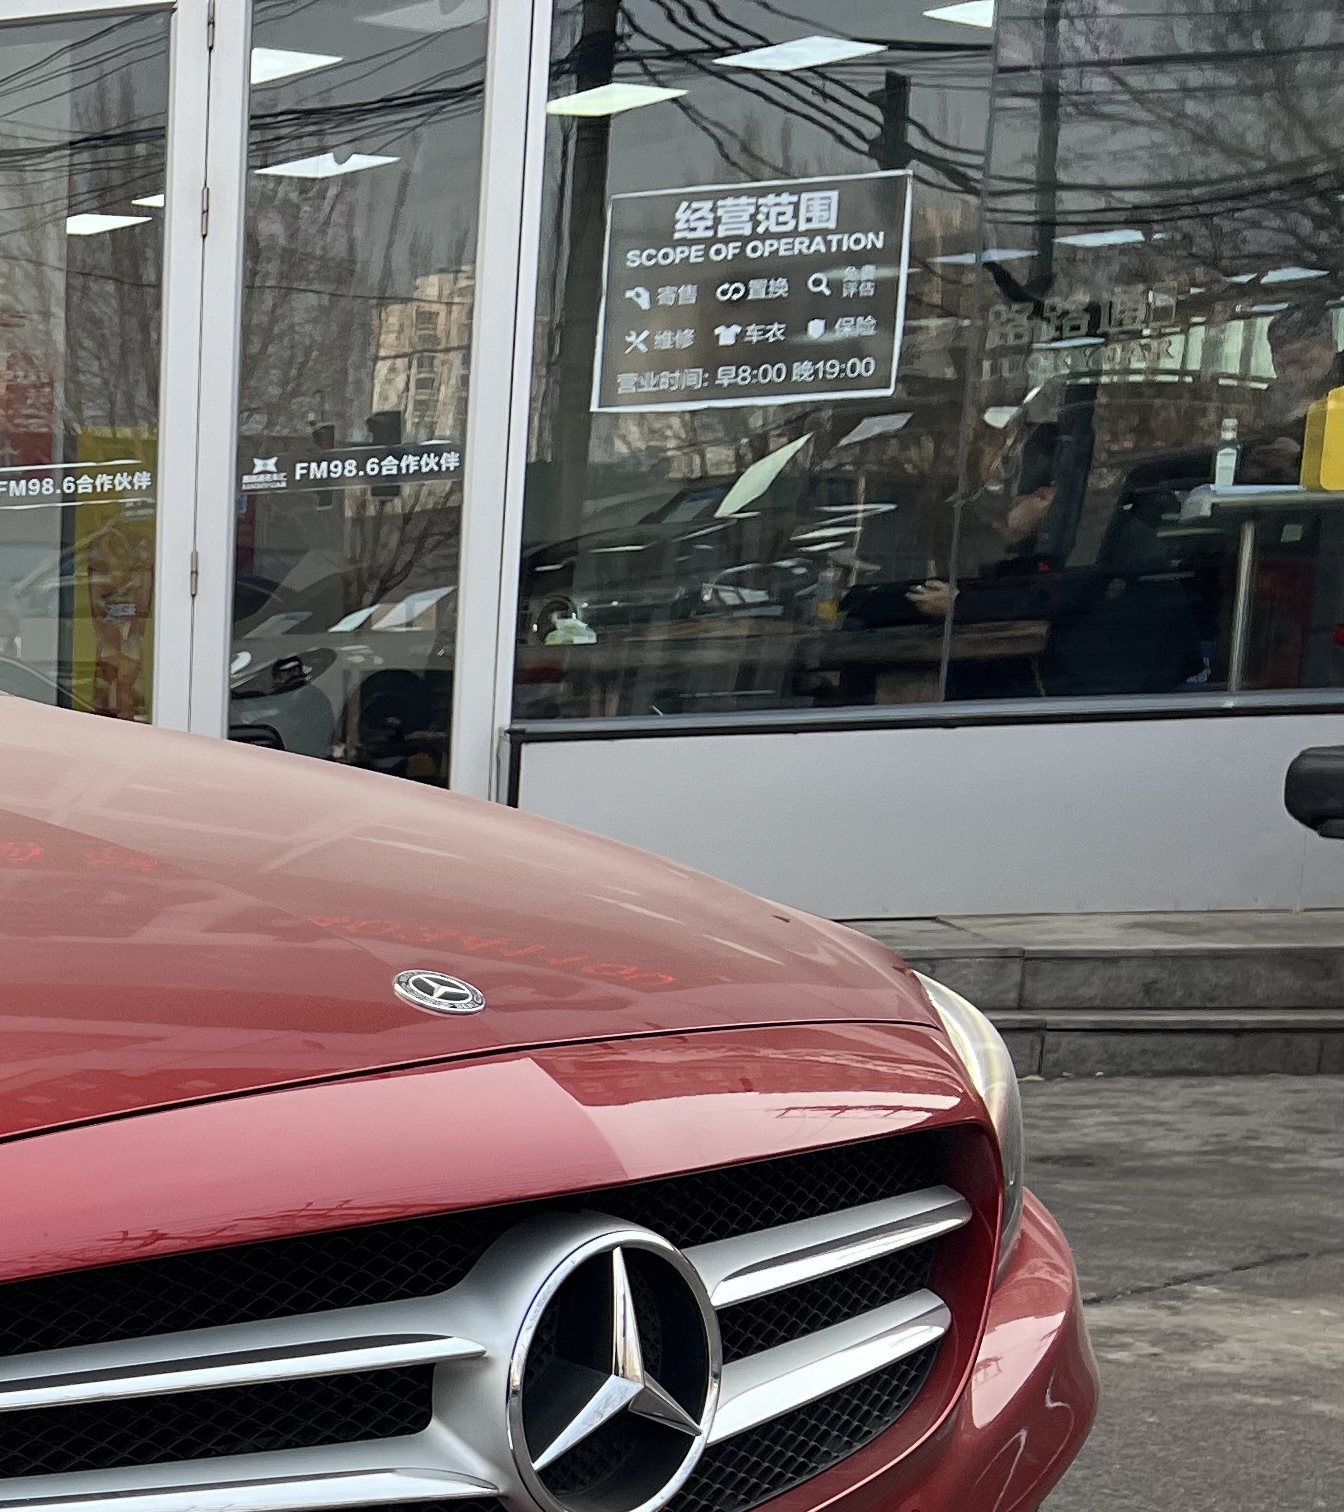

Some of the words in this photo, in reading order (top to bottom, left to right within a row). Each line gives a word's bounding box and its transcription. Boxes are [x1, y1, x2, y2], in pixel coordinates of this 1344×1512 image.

[674, 190, 840, 240] 经营范围
[626, 244, 706, 267] SCOPE
[708, 242, 742, 261] OF
[746, 231, 885, 258] OPERATION
[747, 277, 790, 300] 置换
[744, 322, 787, 344] 车衣
[834, 315, 877, 338] 保险
[295, 451, 460, 480] FM98.6合作伙伴
